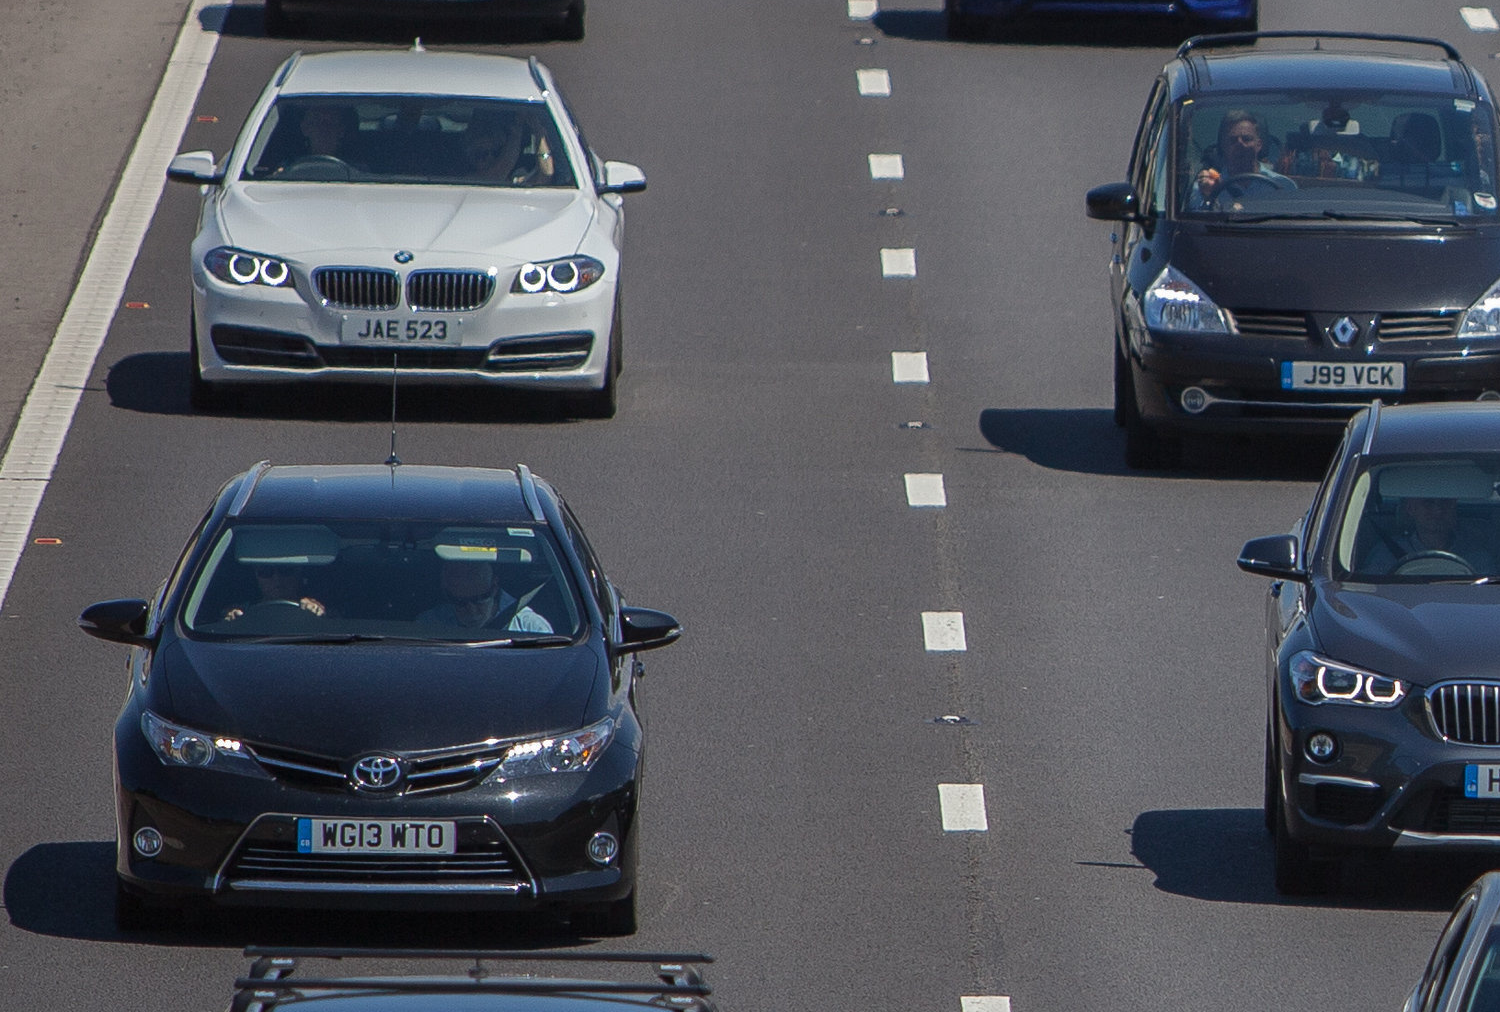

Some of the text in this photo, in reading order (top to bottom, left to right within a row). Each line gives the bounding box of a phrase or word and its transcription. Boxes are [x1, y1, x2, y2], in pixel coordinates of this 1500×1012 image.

[358, 319, 447, 340] JAE 523
[1304, 366, 1345, 385] J99
[1353, 366, 1394, 385] VCK
[322, 822, 443, 849] WG13 WTO
